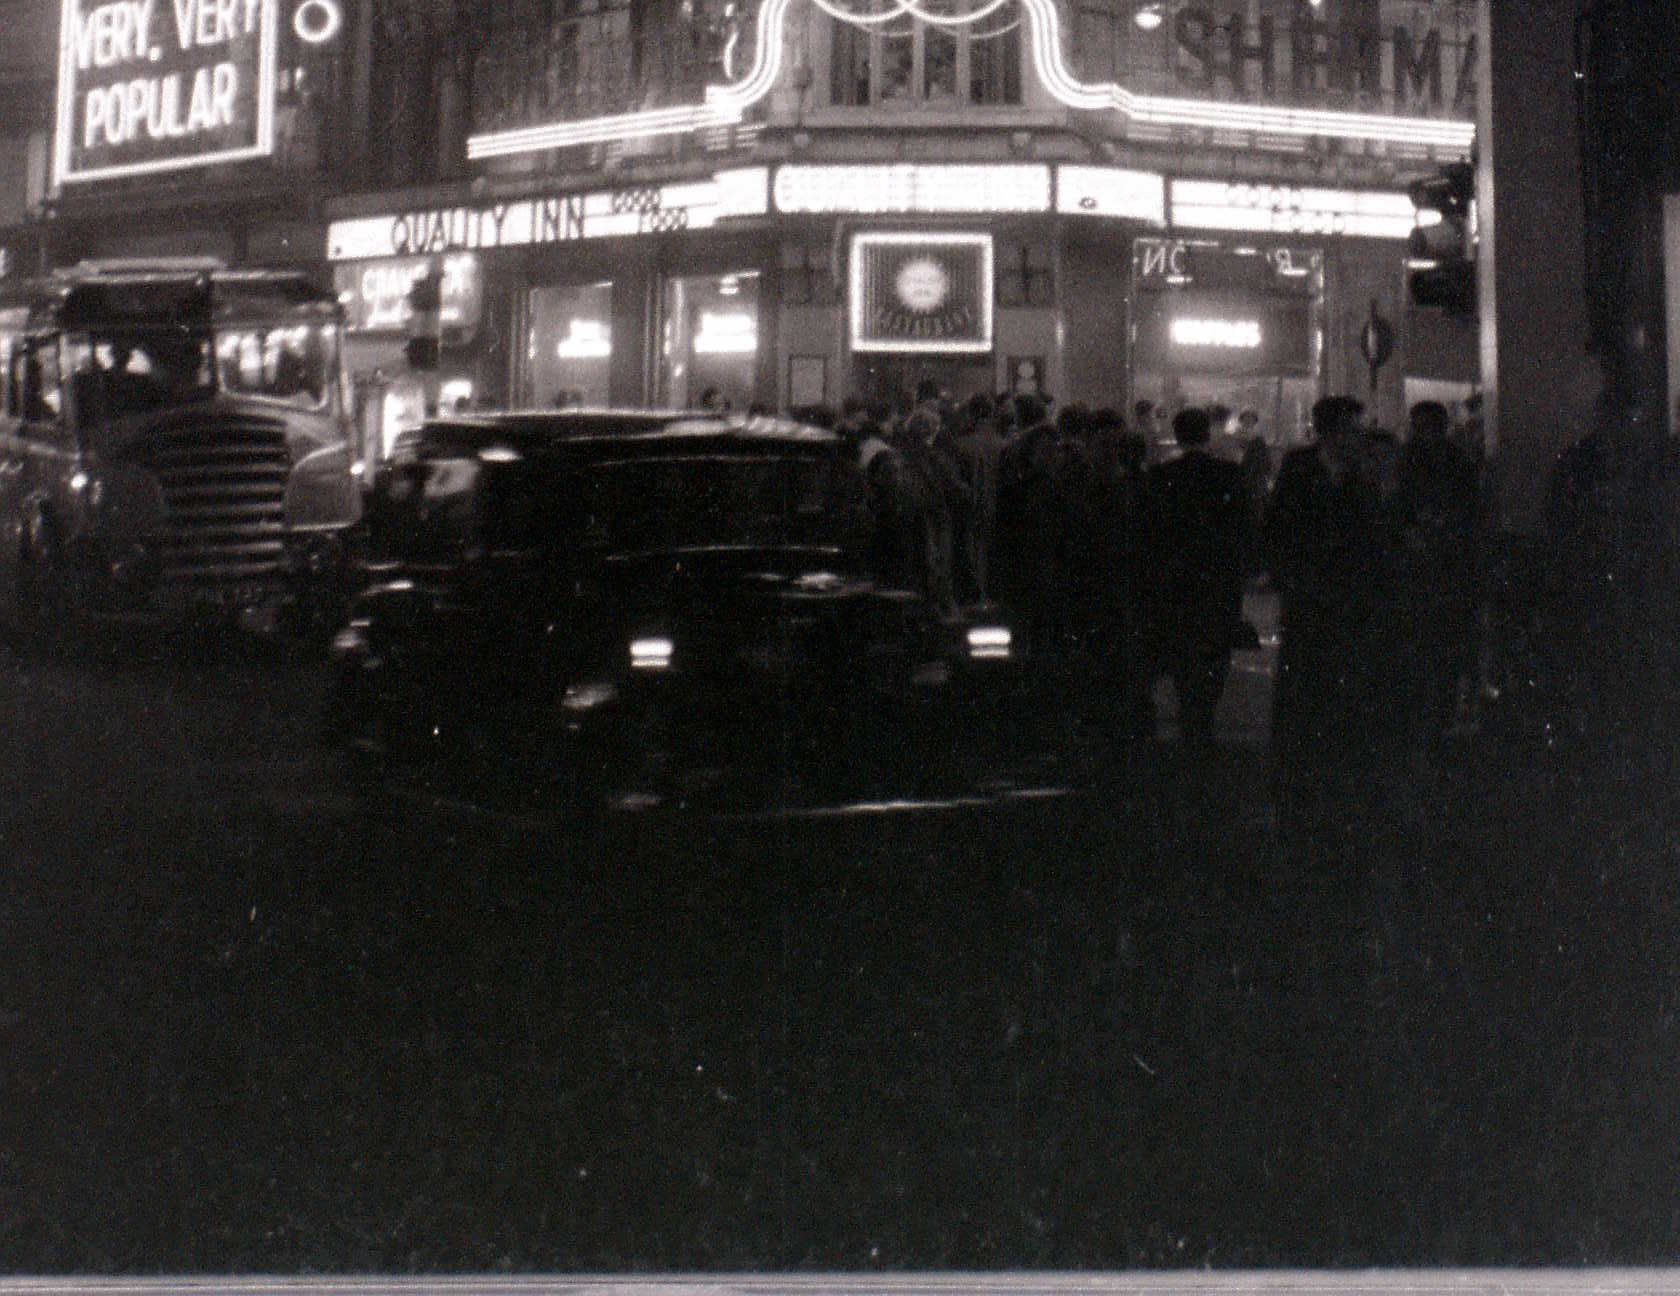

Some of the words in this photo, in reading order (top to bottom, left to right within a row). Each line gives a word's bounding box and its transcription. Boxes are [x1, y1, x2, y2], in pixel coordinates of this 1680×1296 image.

[84, 61, 238, 149] POPULAR
[392, 203, 508, 253] QUALITY
[532, 197, 585, 243] INN
